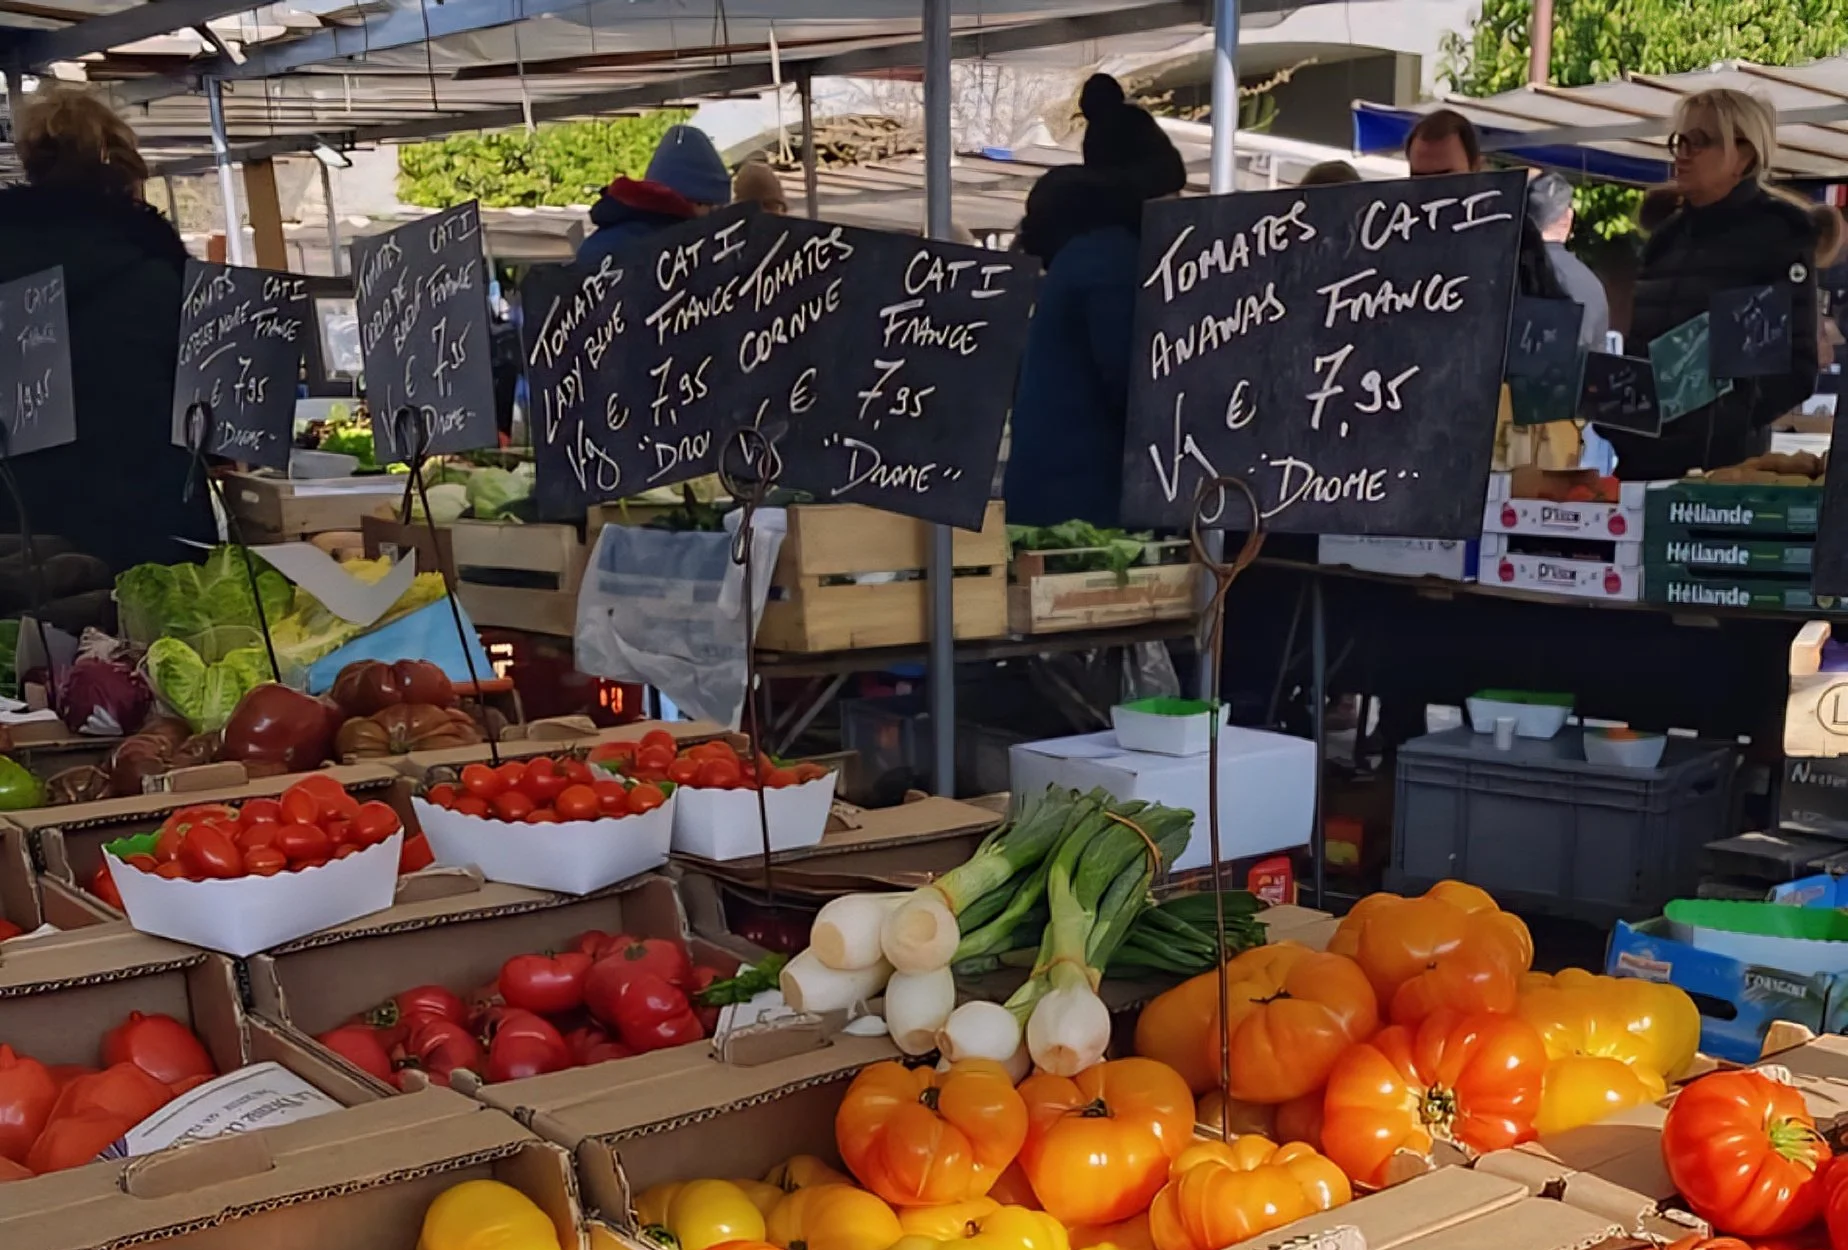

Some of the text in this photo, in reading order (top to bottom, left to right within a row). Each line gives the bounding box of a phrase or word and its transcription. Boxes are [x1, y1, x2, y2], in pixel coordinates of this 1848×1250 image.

[656, 238, 706, 292] CAT
[738, 226, 854, 313] TOMATES
[904, 249, 978, 296] CAT
[1143, 200, 1317, 303] TOMATES
[530, 254, 624, 369] TOMATES
[645, 275, 740, 346] FRANCE
[739, 277, 843, 374] CORNUE
[879, 298, 989, 356] FRANCE
[1152, 281, 1286, 381] ANANAS
[1316, 268, 1471, 329] FRANCE
[544, 300, 626, 445] LADY BLUE
[650, 355, 713, 427] 7,95
[789, 357, 937, 431] € 7,95
[1225, 343, 1421, 439] € 7,95
